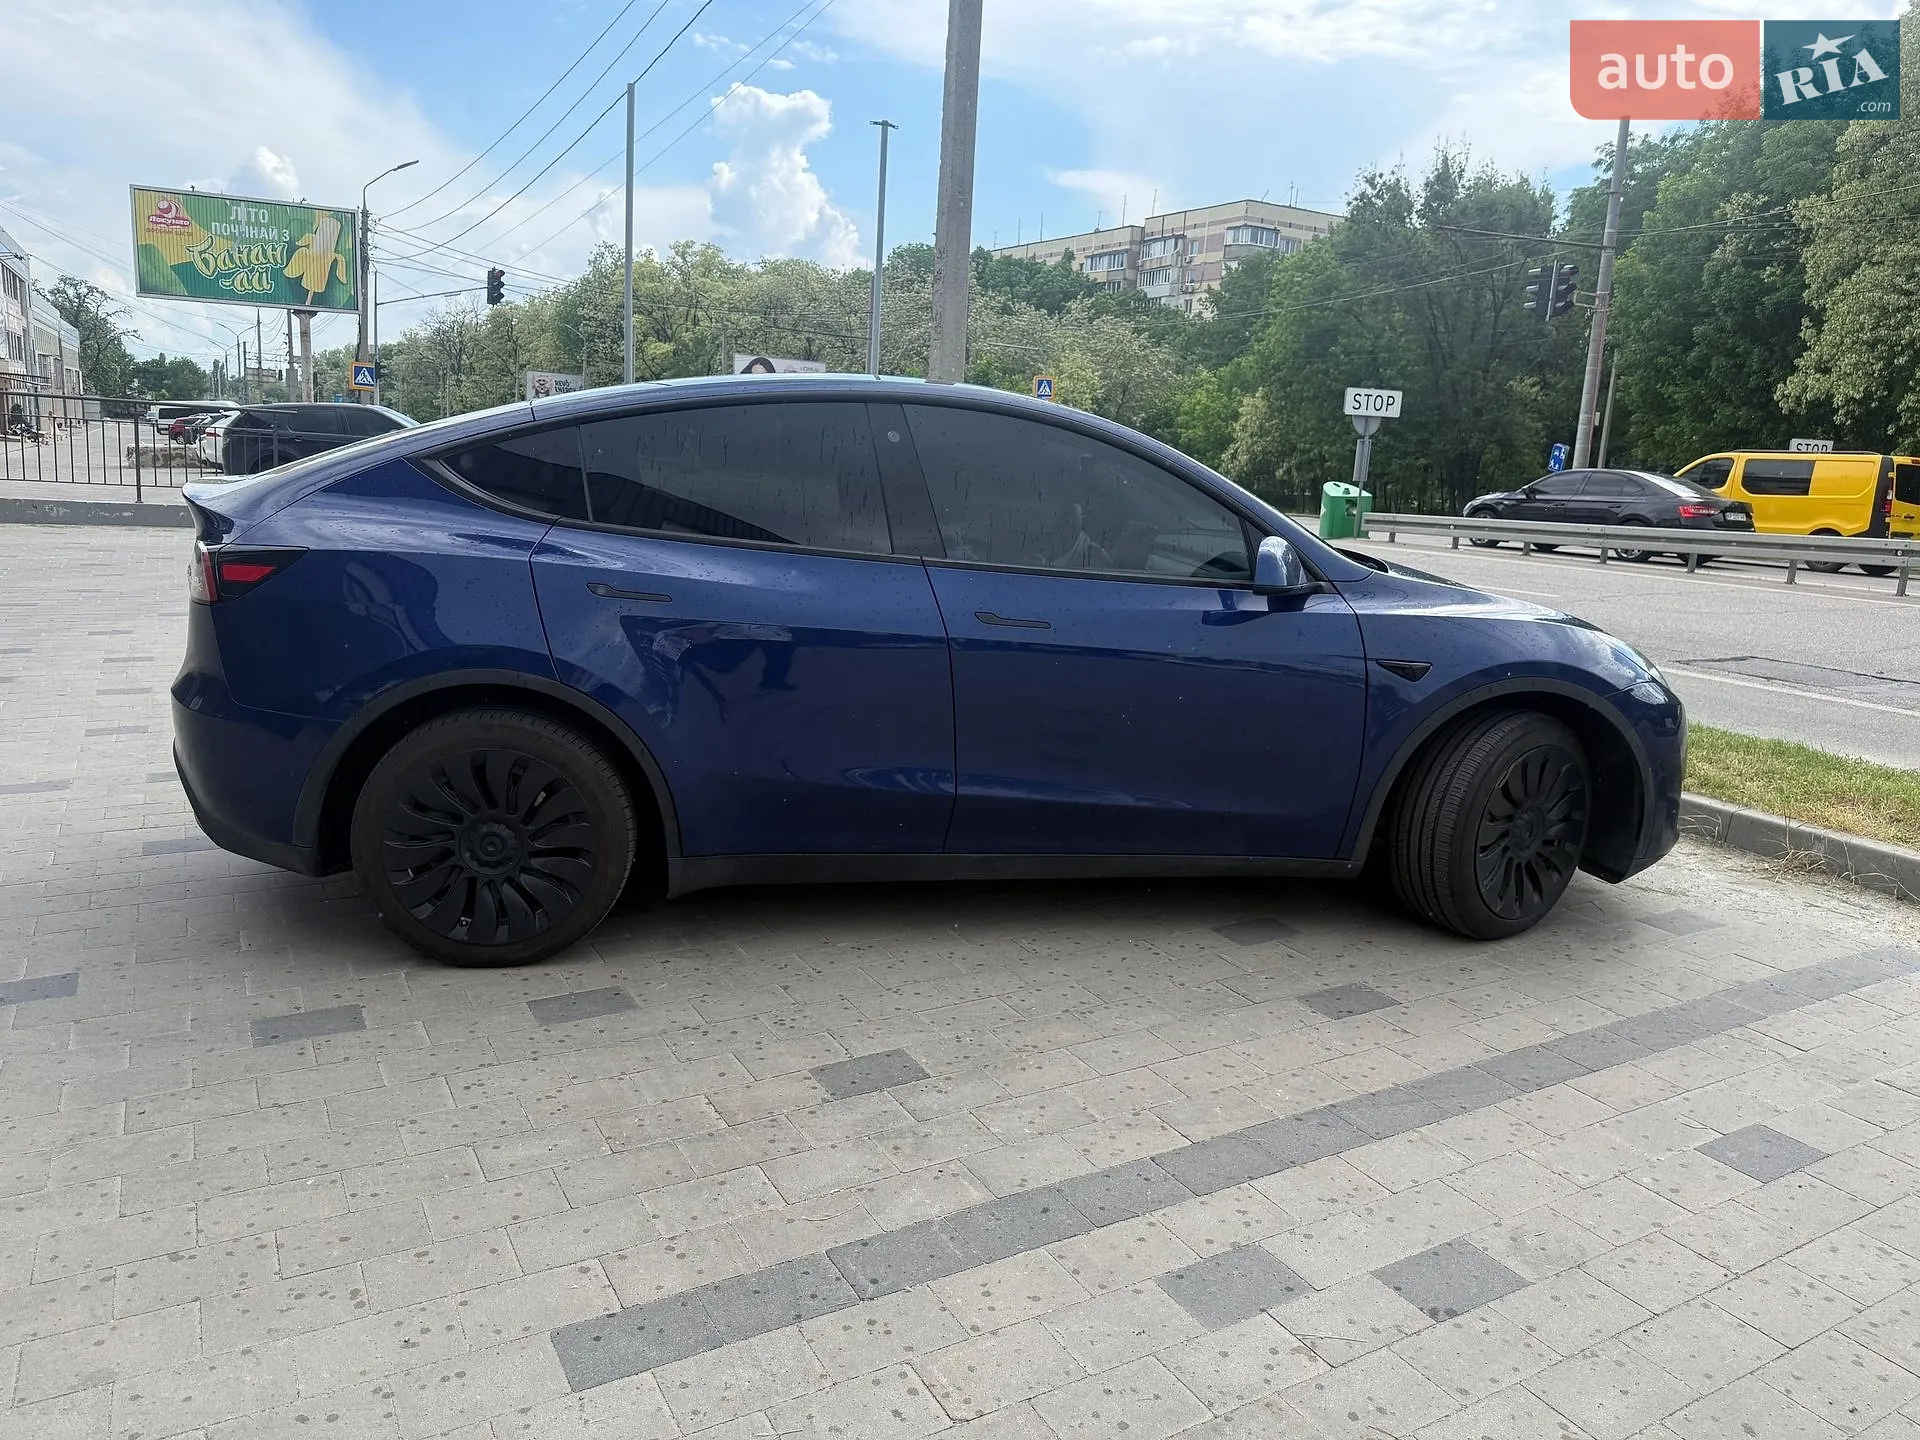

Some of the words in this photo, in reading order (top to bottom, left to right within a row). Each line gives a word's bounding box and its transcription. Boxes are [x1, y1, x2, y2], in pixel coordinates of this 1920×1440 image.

[230, 206, 269, 223] ЛІТО
[211, 222, 278, 242] ПОЧИНАЙ
[1352, 393, 1396, 412] STOP
